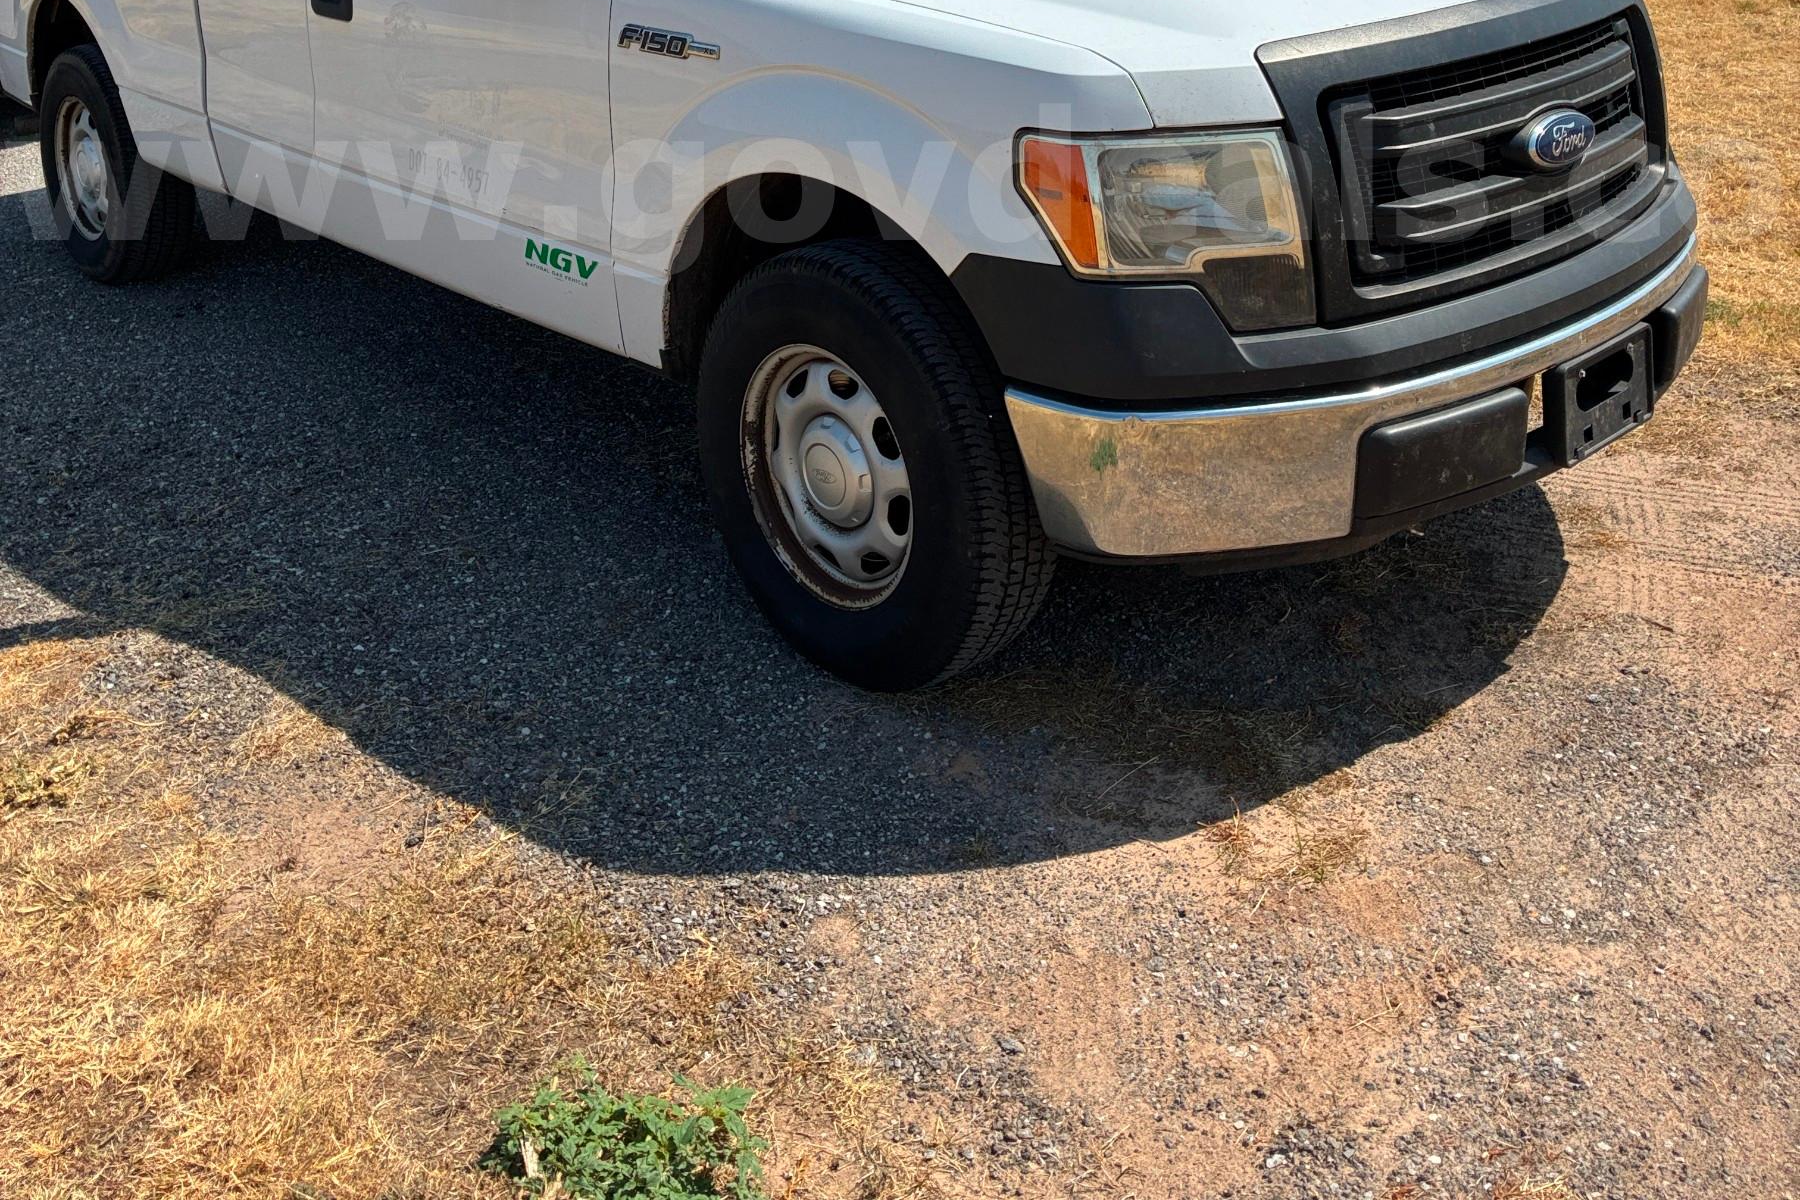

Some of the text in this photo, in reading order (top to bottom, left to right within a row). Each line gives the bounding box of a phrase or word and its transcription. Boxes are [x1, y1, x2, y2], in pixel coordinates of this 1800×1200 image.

[1552, 121, 1587, 156] Ford
[525, 238, 599, 280] NGV
[551, 270, 563, 278] GAS
[564, 275, 588, 287] VEHICLE
